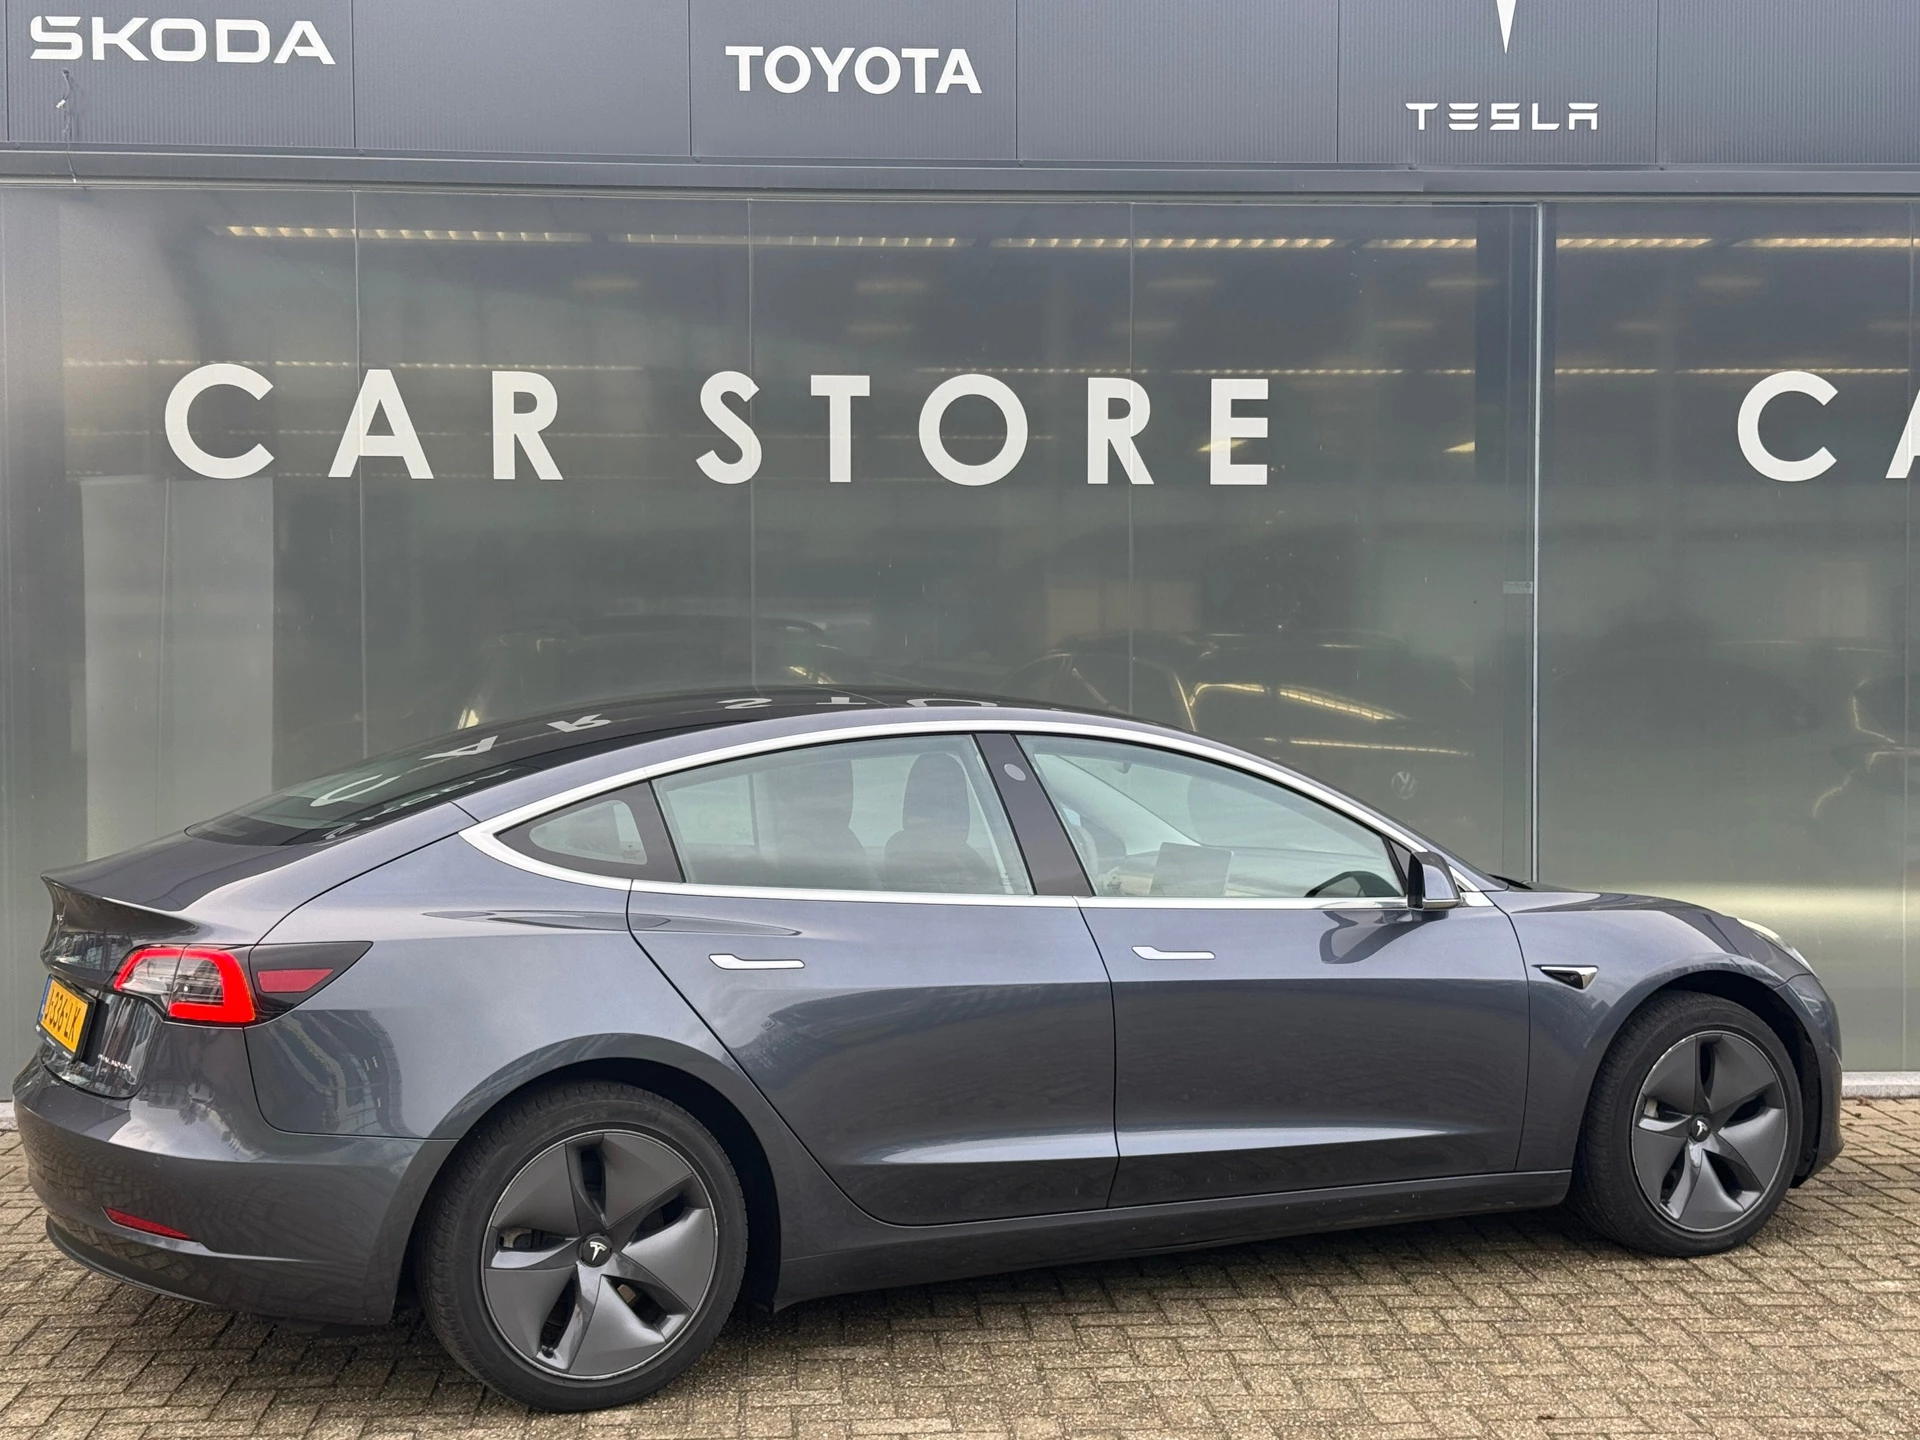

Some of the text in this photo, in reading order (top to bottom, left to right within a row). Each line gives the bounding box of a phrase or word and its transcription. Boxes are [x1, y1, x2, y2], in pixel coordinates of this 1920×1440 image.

[725, 46, 983, 95] TOYOTA
[1406, 102, 1599, 131] TESLA
[164, 363, 1269, 486] CAR STORE
